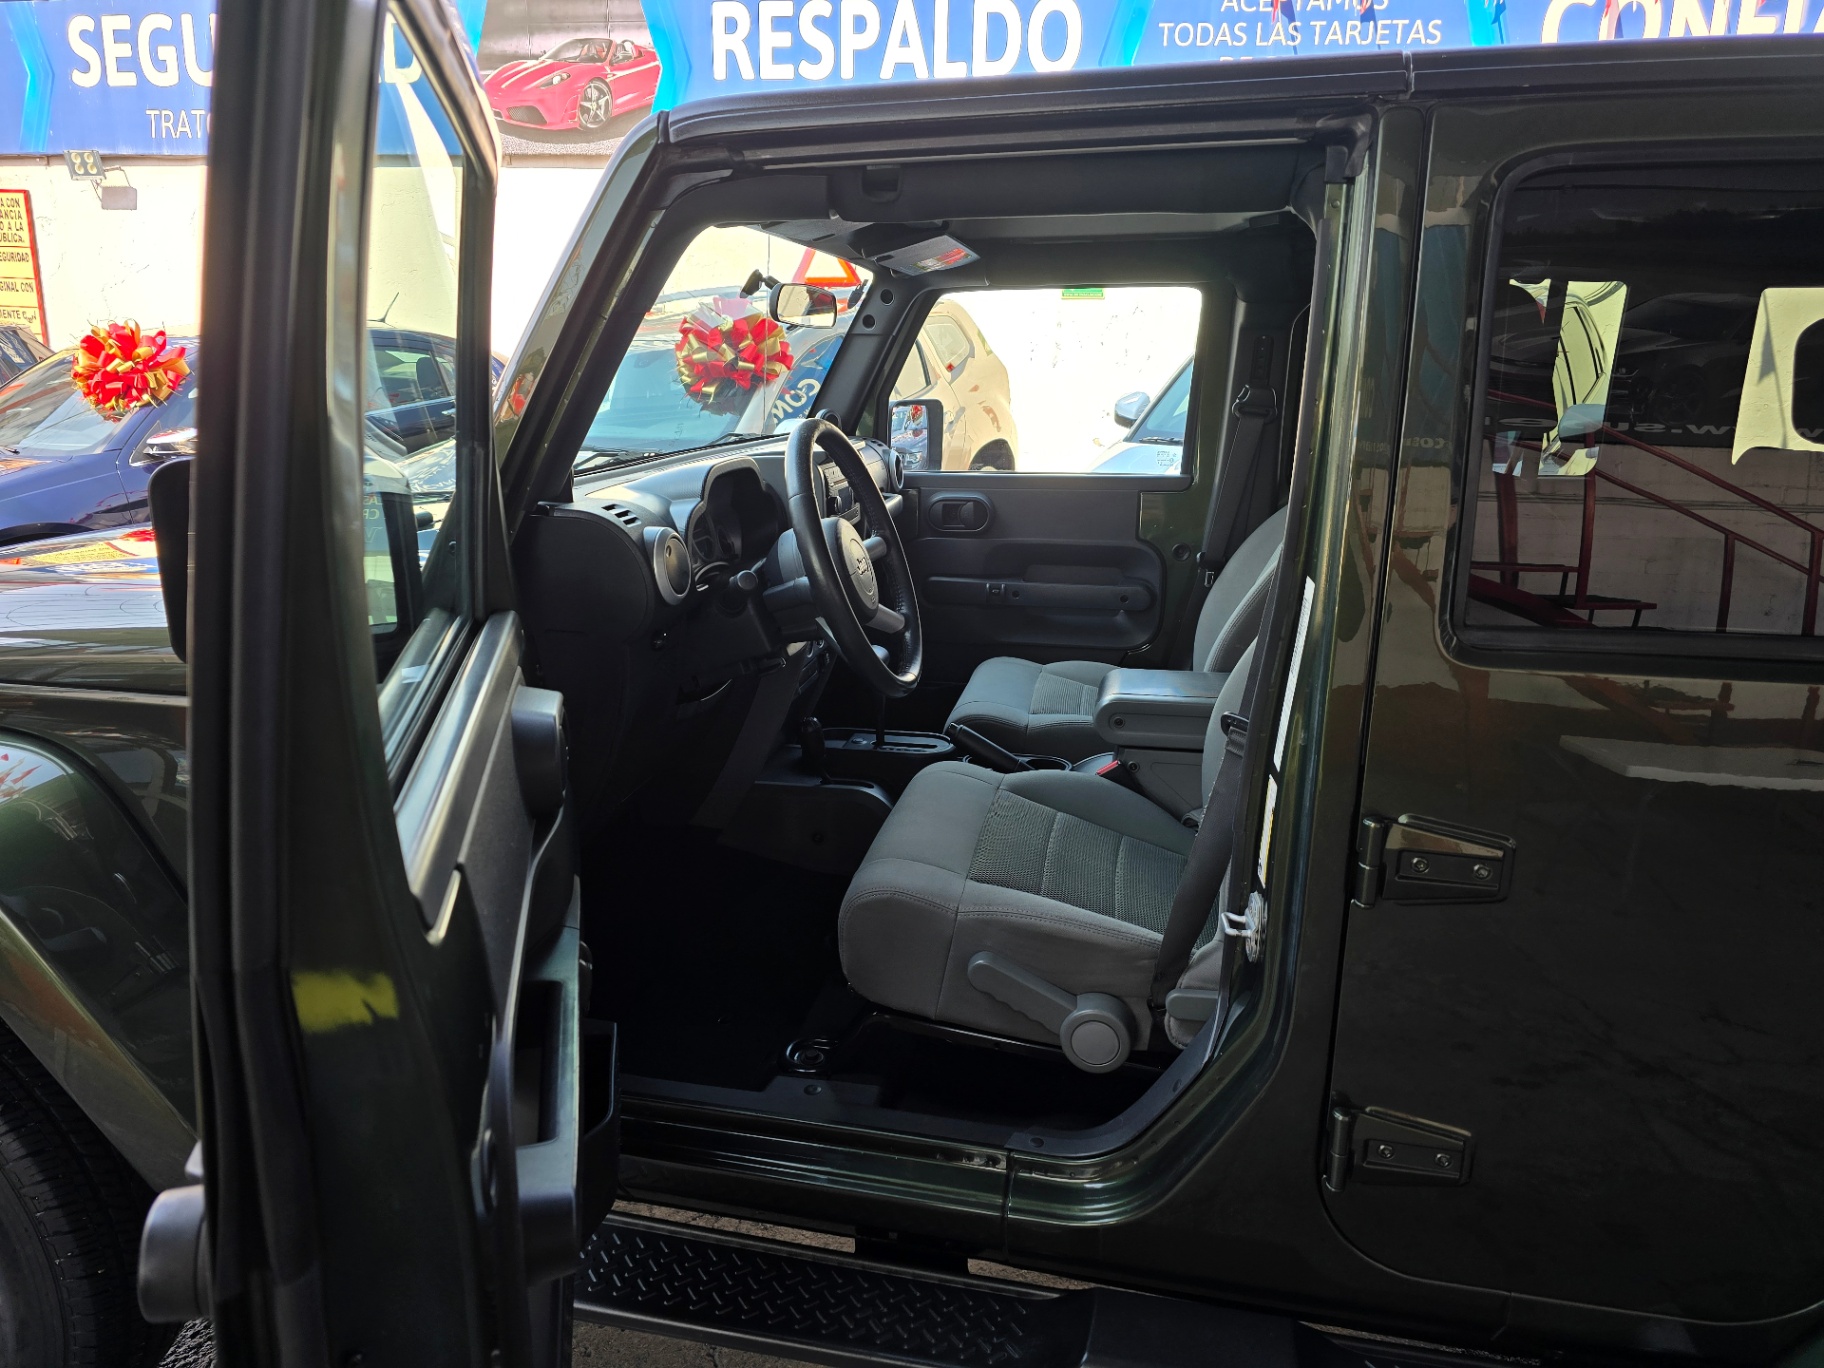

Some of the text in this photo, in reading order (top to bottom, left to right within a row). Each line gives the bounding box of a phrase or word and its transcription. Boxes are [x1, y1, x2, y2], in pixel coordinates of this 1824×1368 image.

[711, 0, 1083, 81] RESPALDO
[1159, 19, 1442, 47] TODAS LAS TARJETAS
[145, 109, 210, 139] TRAT
